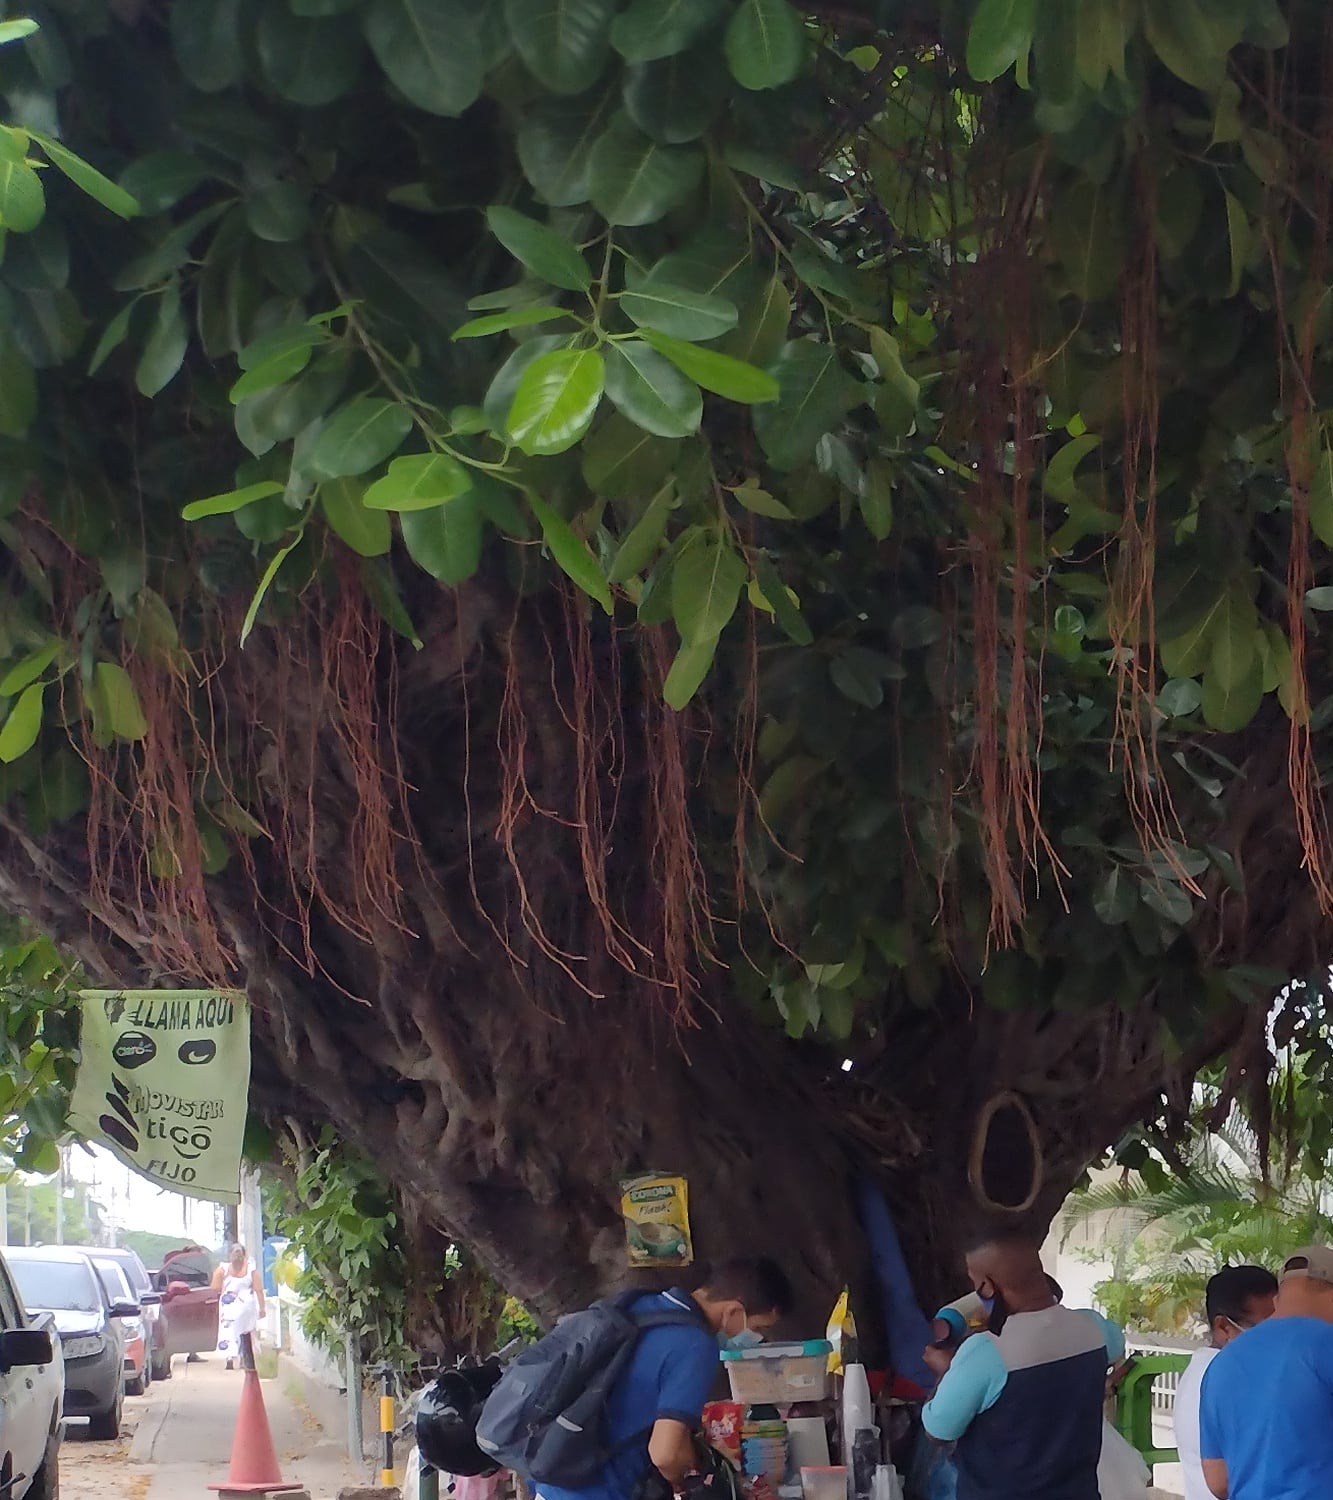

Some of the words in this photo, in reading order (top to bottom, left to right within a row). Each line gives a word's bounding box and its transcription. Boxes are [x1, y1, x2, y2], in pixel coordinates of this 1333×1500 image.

[128, 999, 191, 1030] LLAMA
[195, 996, 233, 1029] AQUI
[146, 1160, 196, 1182] FIJO
